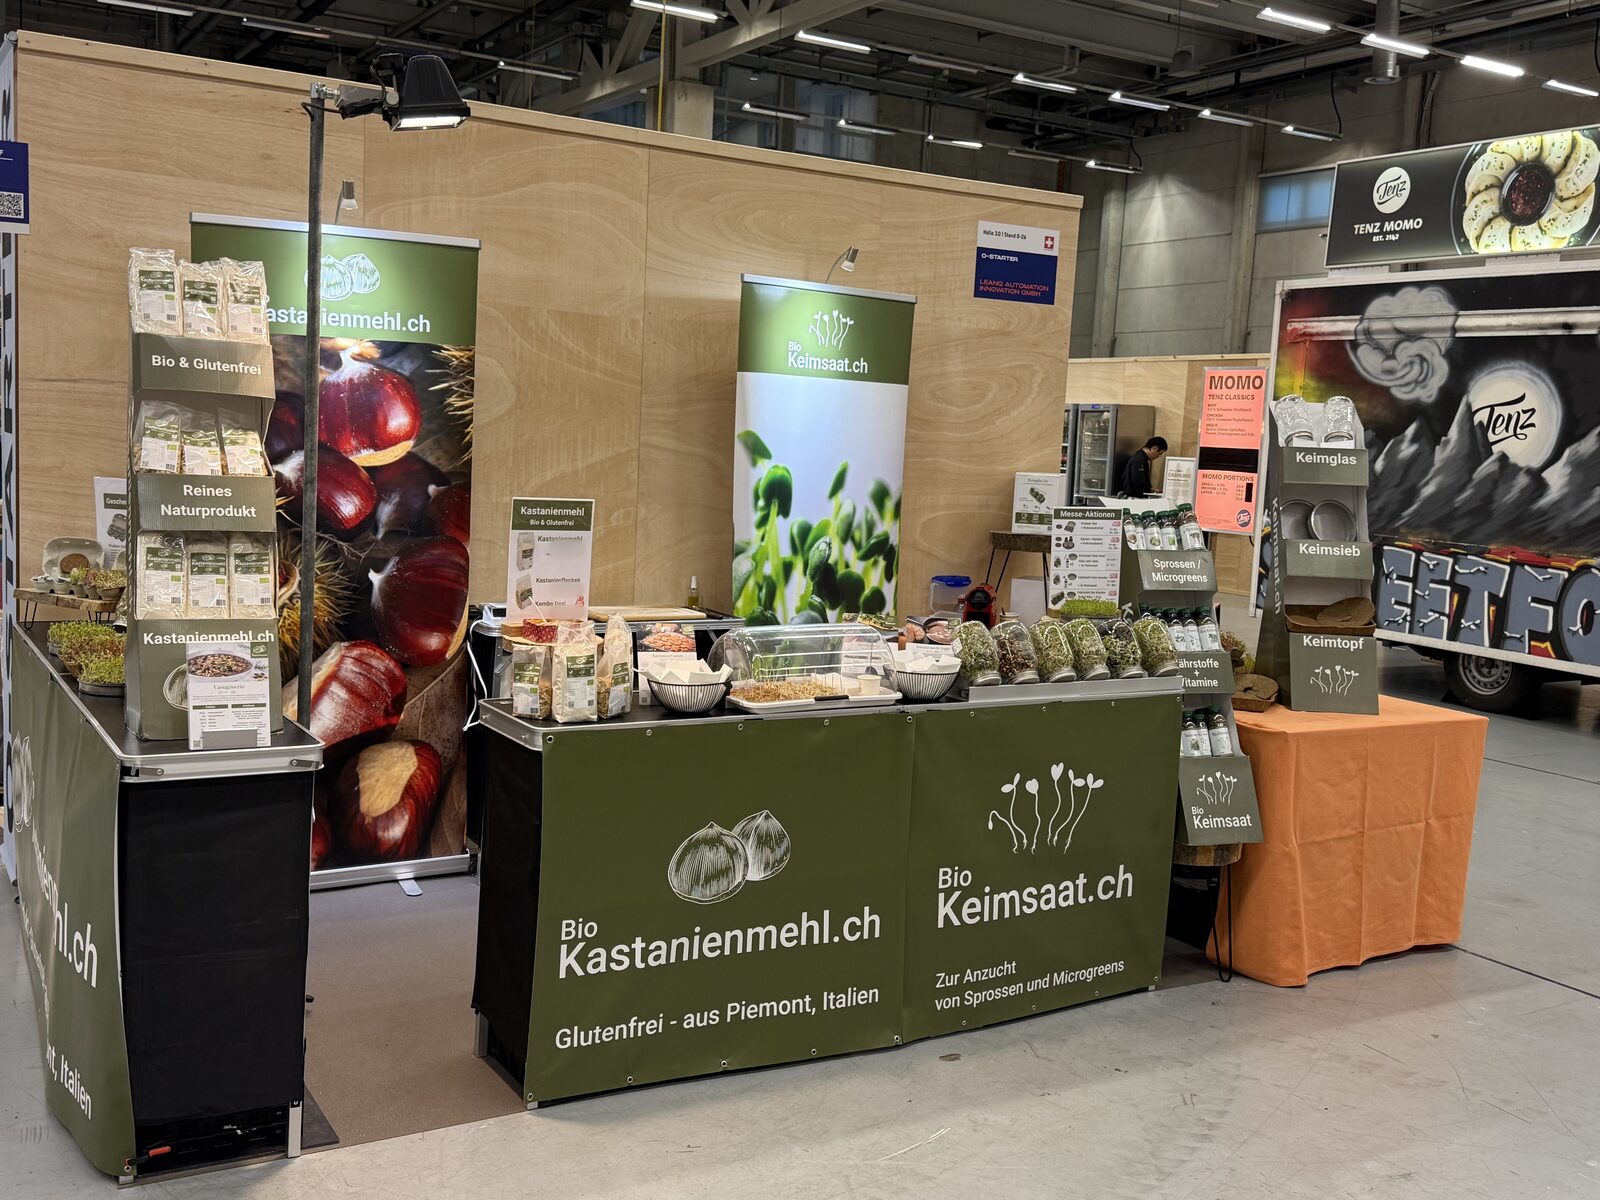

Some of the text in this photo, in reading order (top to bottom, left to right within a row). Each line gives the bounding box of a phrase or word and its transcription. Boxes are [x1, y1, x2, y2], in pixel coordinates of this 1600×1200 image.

[1376, 174, 1407, 206] Tenz
[1353, 217, 1423, 235] TENZ MOMO
[979, 285, 1020, 295] INNOVATION
[1004, 282, 1049, 291] AUTOMATION
[266, 307, 431, 334] astaienmehl.ch
[788, 340, 801, 352] Bio
[151, 354, 262, 376] Bio & Glutenfrei
[788, 352, 868, 375] Keimsaat.ch
[1208, 374, 1264, 390] MOMO
[1472, 393, 1537, 447] Tenz
[1296, 451, 1357, 466] Keimglas
[183, 484, 232, 497] Reines
[161, 504, 257, 519] Naturprodukt
[520, 506, 585, 516] Kastanienmehl
[1060, 510, 1115, 518] Messe-Aktionen
[1299, 543, 1361, 557] Keimsieb
[1153, 558, 1196, 570] Sprossen
[1151, 572, 1208, 584] Microgreens
[143, 630, 275, 645] Kastanienmehl.ch
[1303, 635, 1365, 652] Keimtopf
[1176, 658, 1220, 669] ährstoffe
[1191, 806, 1204, 815] Bio
[1193, 814, 1253, 829] Keimsaat
[938, 866, 972, 889] Bio
[937, 864, 1133, 929] Keimsaat.ch
[561, 918, 598, 941] Bio
[558, 906, 881, 979] Kastanienmehl.ch
[935, 960, 1017, 988] Zur Anzucht
[935, 960, 1125, 1011] von Sprossen und Microgreens
[555, 1014, 664, 1050] Glutenfrei
[683, 1008, 720, 1029] aus
[727, 994, 817, 1023] Piemont,
[823, 986, 879, 1012] Italien
[60, 1053, 92, 1121] Italien
